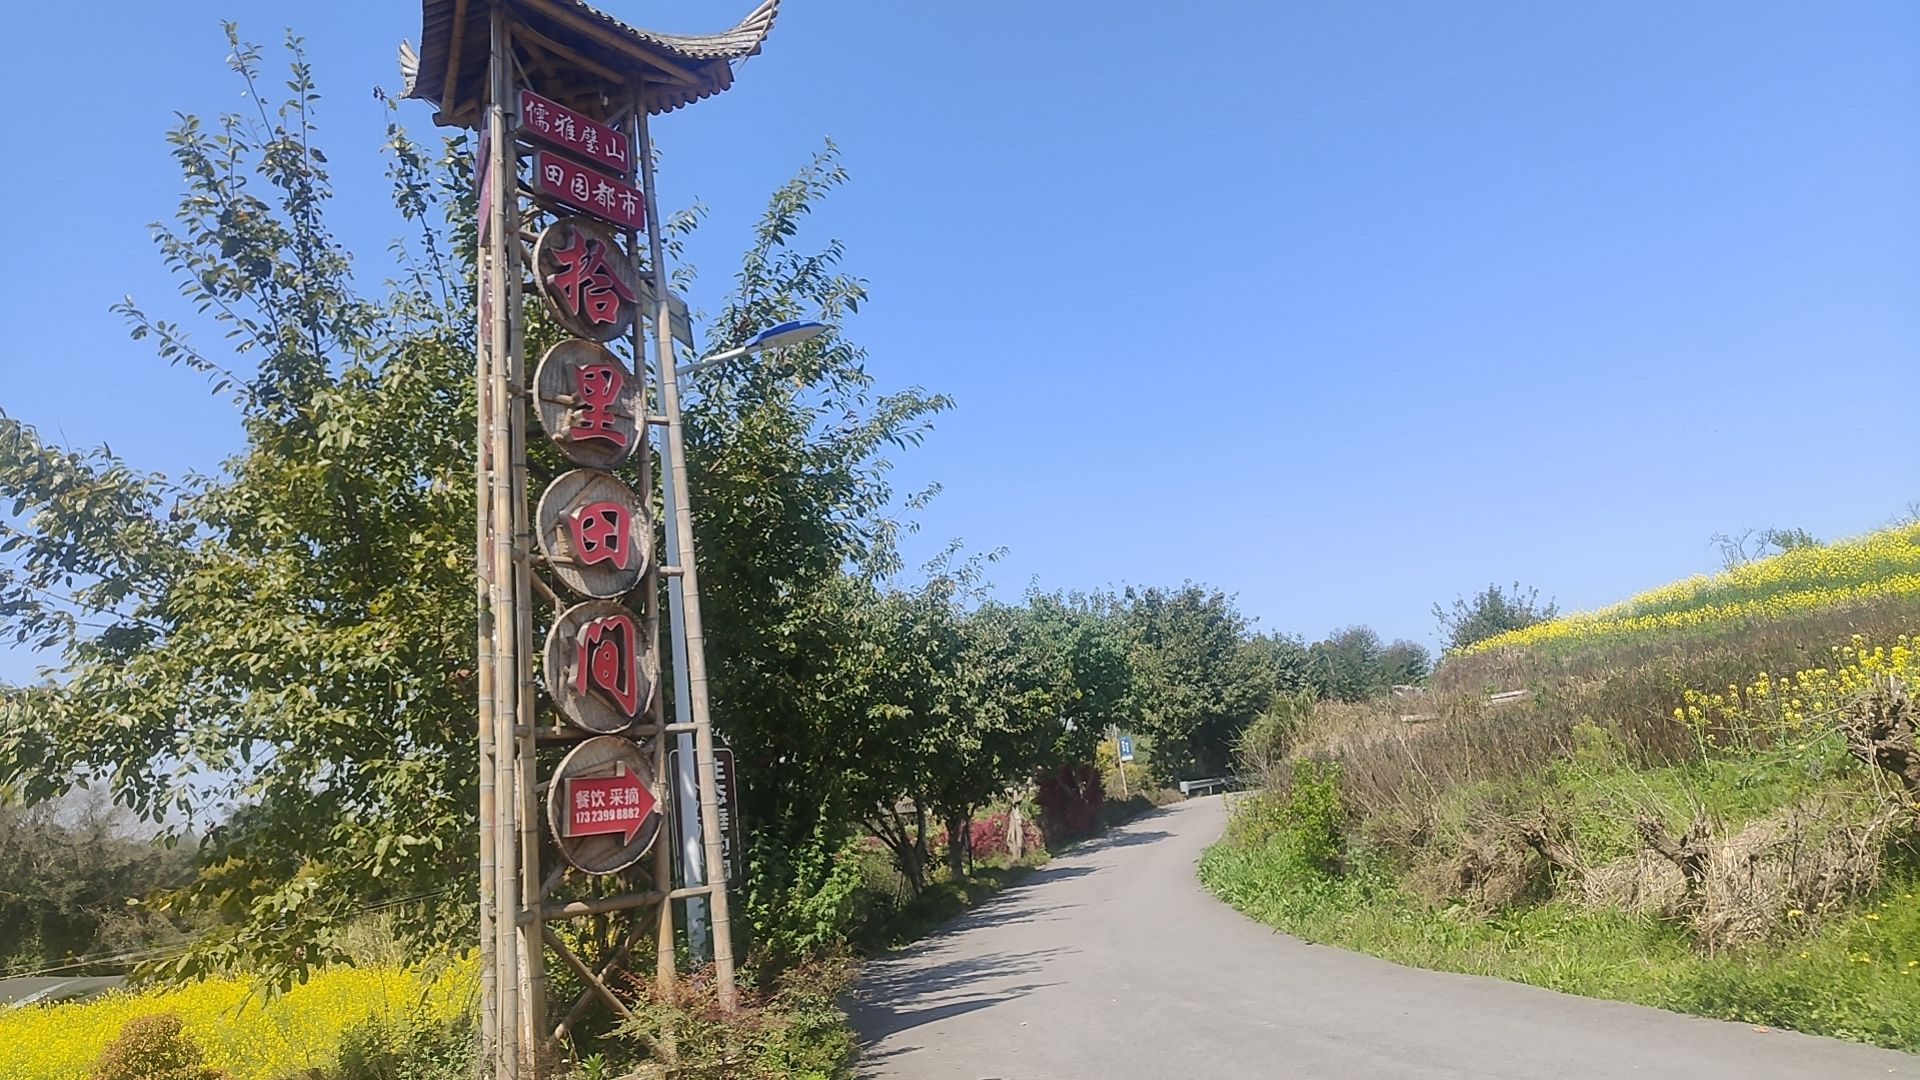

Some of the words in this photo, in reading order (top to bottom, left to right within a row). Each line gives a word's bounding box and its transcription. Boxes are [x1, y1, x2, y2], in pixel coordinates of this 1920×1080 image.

[525, 100, 625, 162] 儒雅璧山
[544, 164, 639, 220] 田园都市
[575, 789, 605, 809] 餐饮
[609, 787, 639, 806] 采摘
